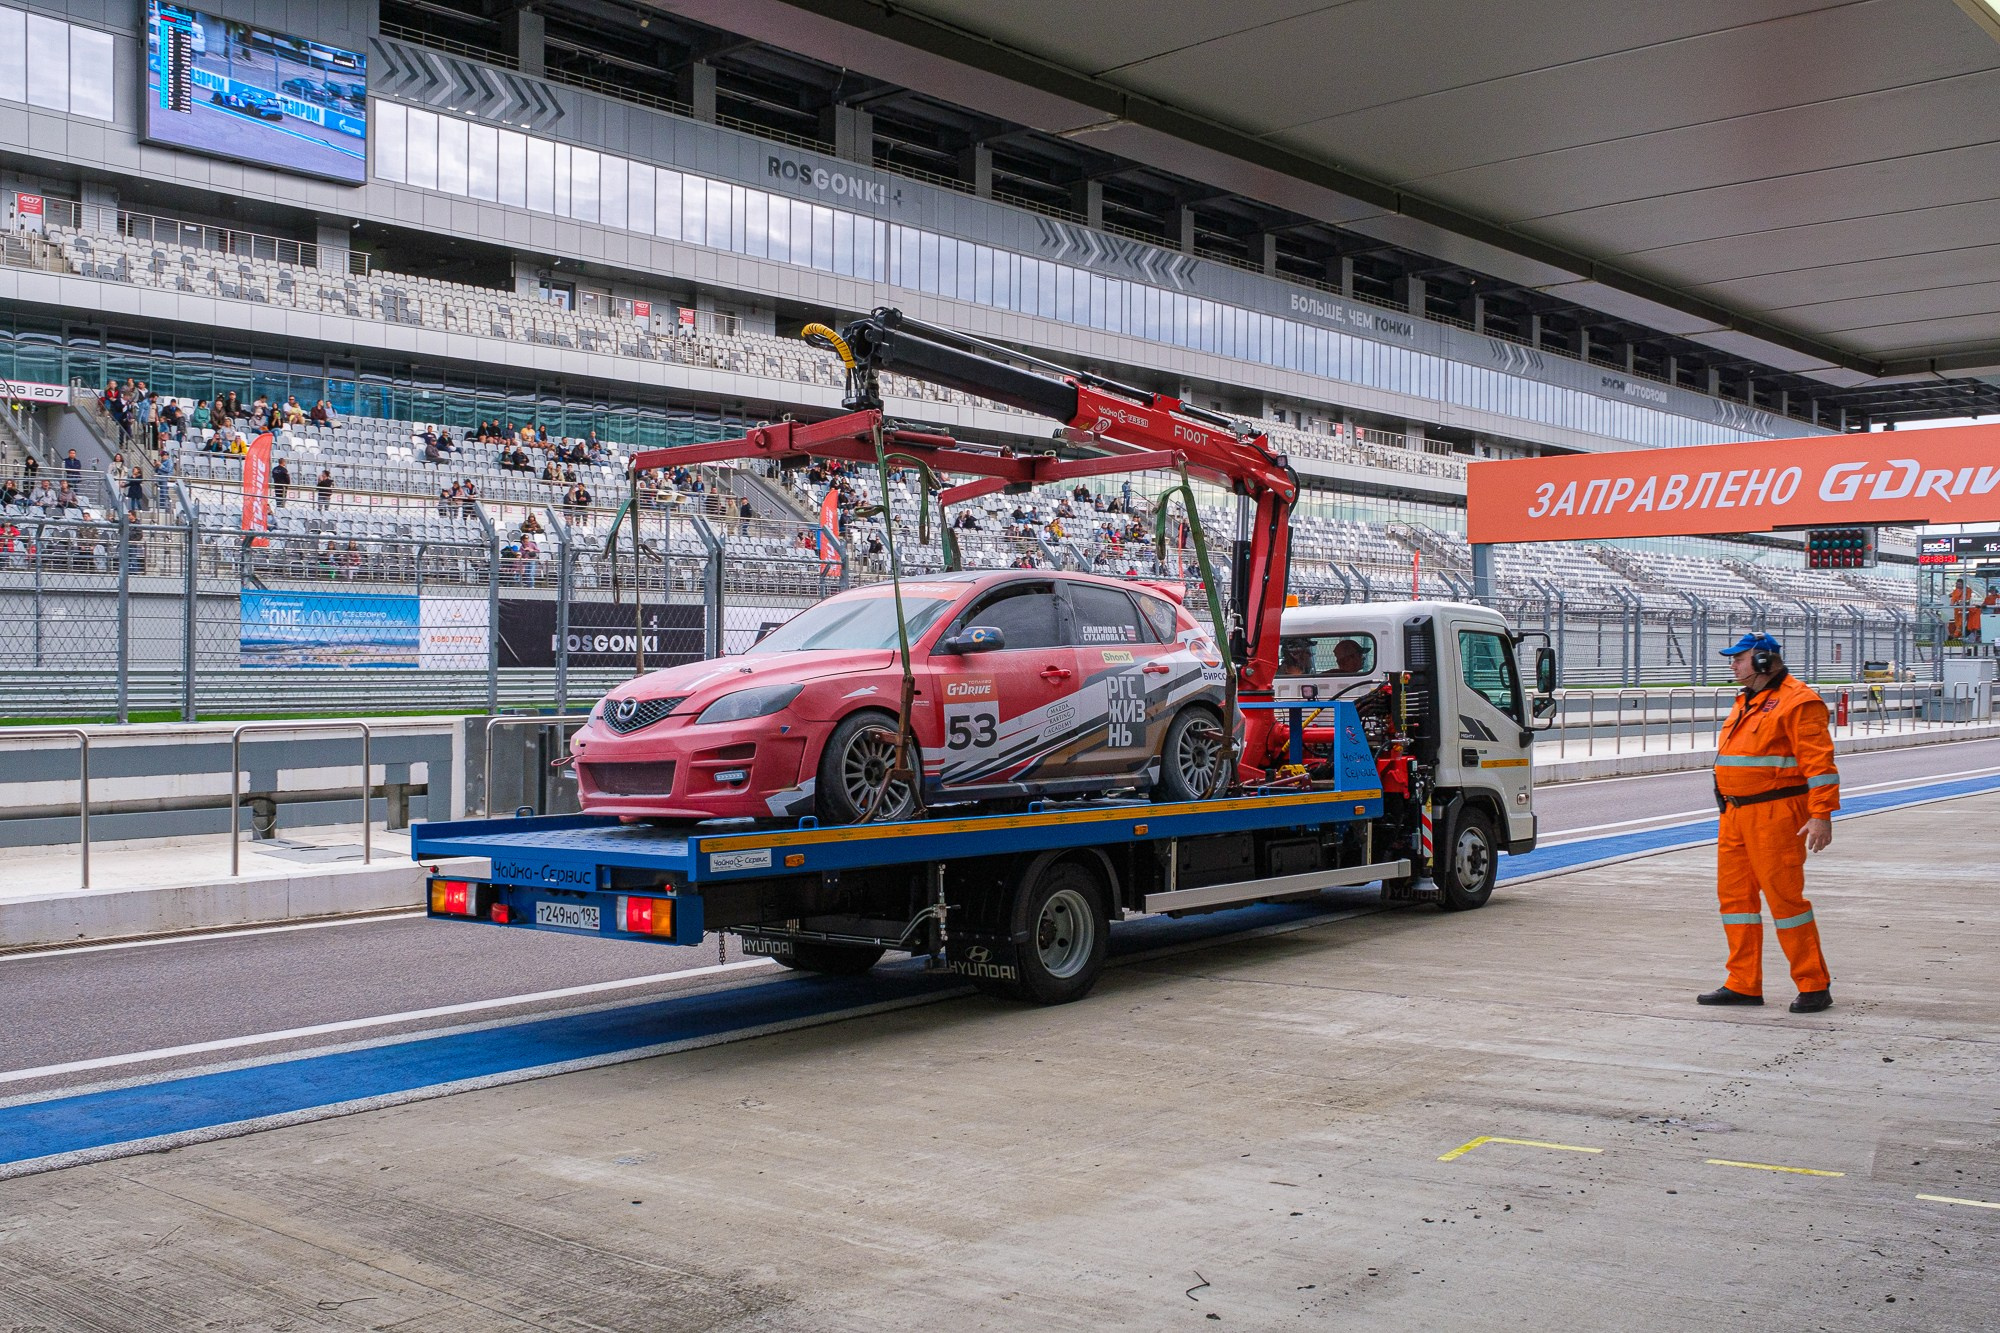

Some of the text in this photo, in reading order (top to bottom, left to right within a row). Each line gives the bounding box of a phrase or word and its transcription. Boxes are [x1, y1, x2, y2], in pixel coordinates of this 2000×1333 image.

[768, 156, 885, 205] ROSGONKI
[1291, 294, 1414, 340] БОЛЬШЕ, ЧЕМ ГОНКИ!
[35, 387, 64, 398] 207
[1099, 405, 1118, 418] Чайка
[1127, 414, 1149, 428] FASSI
[1174, 424, 1209, 446] F100T
[1528, 466, 1803, 518] ЗАПРАВЛЕНО
[1082, 626, 1117, 634] СМИРНОВ
[1106, 676, 1137, 699] РГС
[1050, 703, 1070, 713] MAZDA
[1109, 700, 1146, 723] ЖИЗ
[1049, 711, 1071, 724] KARTING
[947, 713, 997, 750] 53
[1047, 720, 1073, 734] ACADEMY
[1108, 723, 1133, 747] НЬ
[580, 907, 597, 921] 193
[743, 939, 794, 954] HYUNDAI
[949, 960, 1016, 979] HYUNDAI
